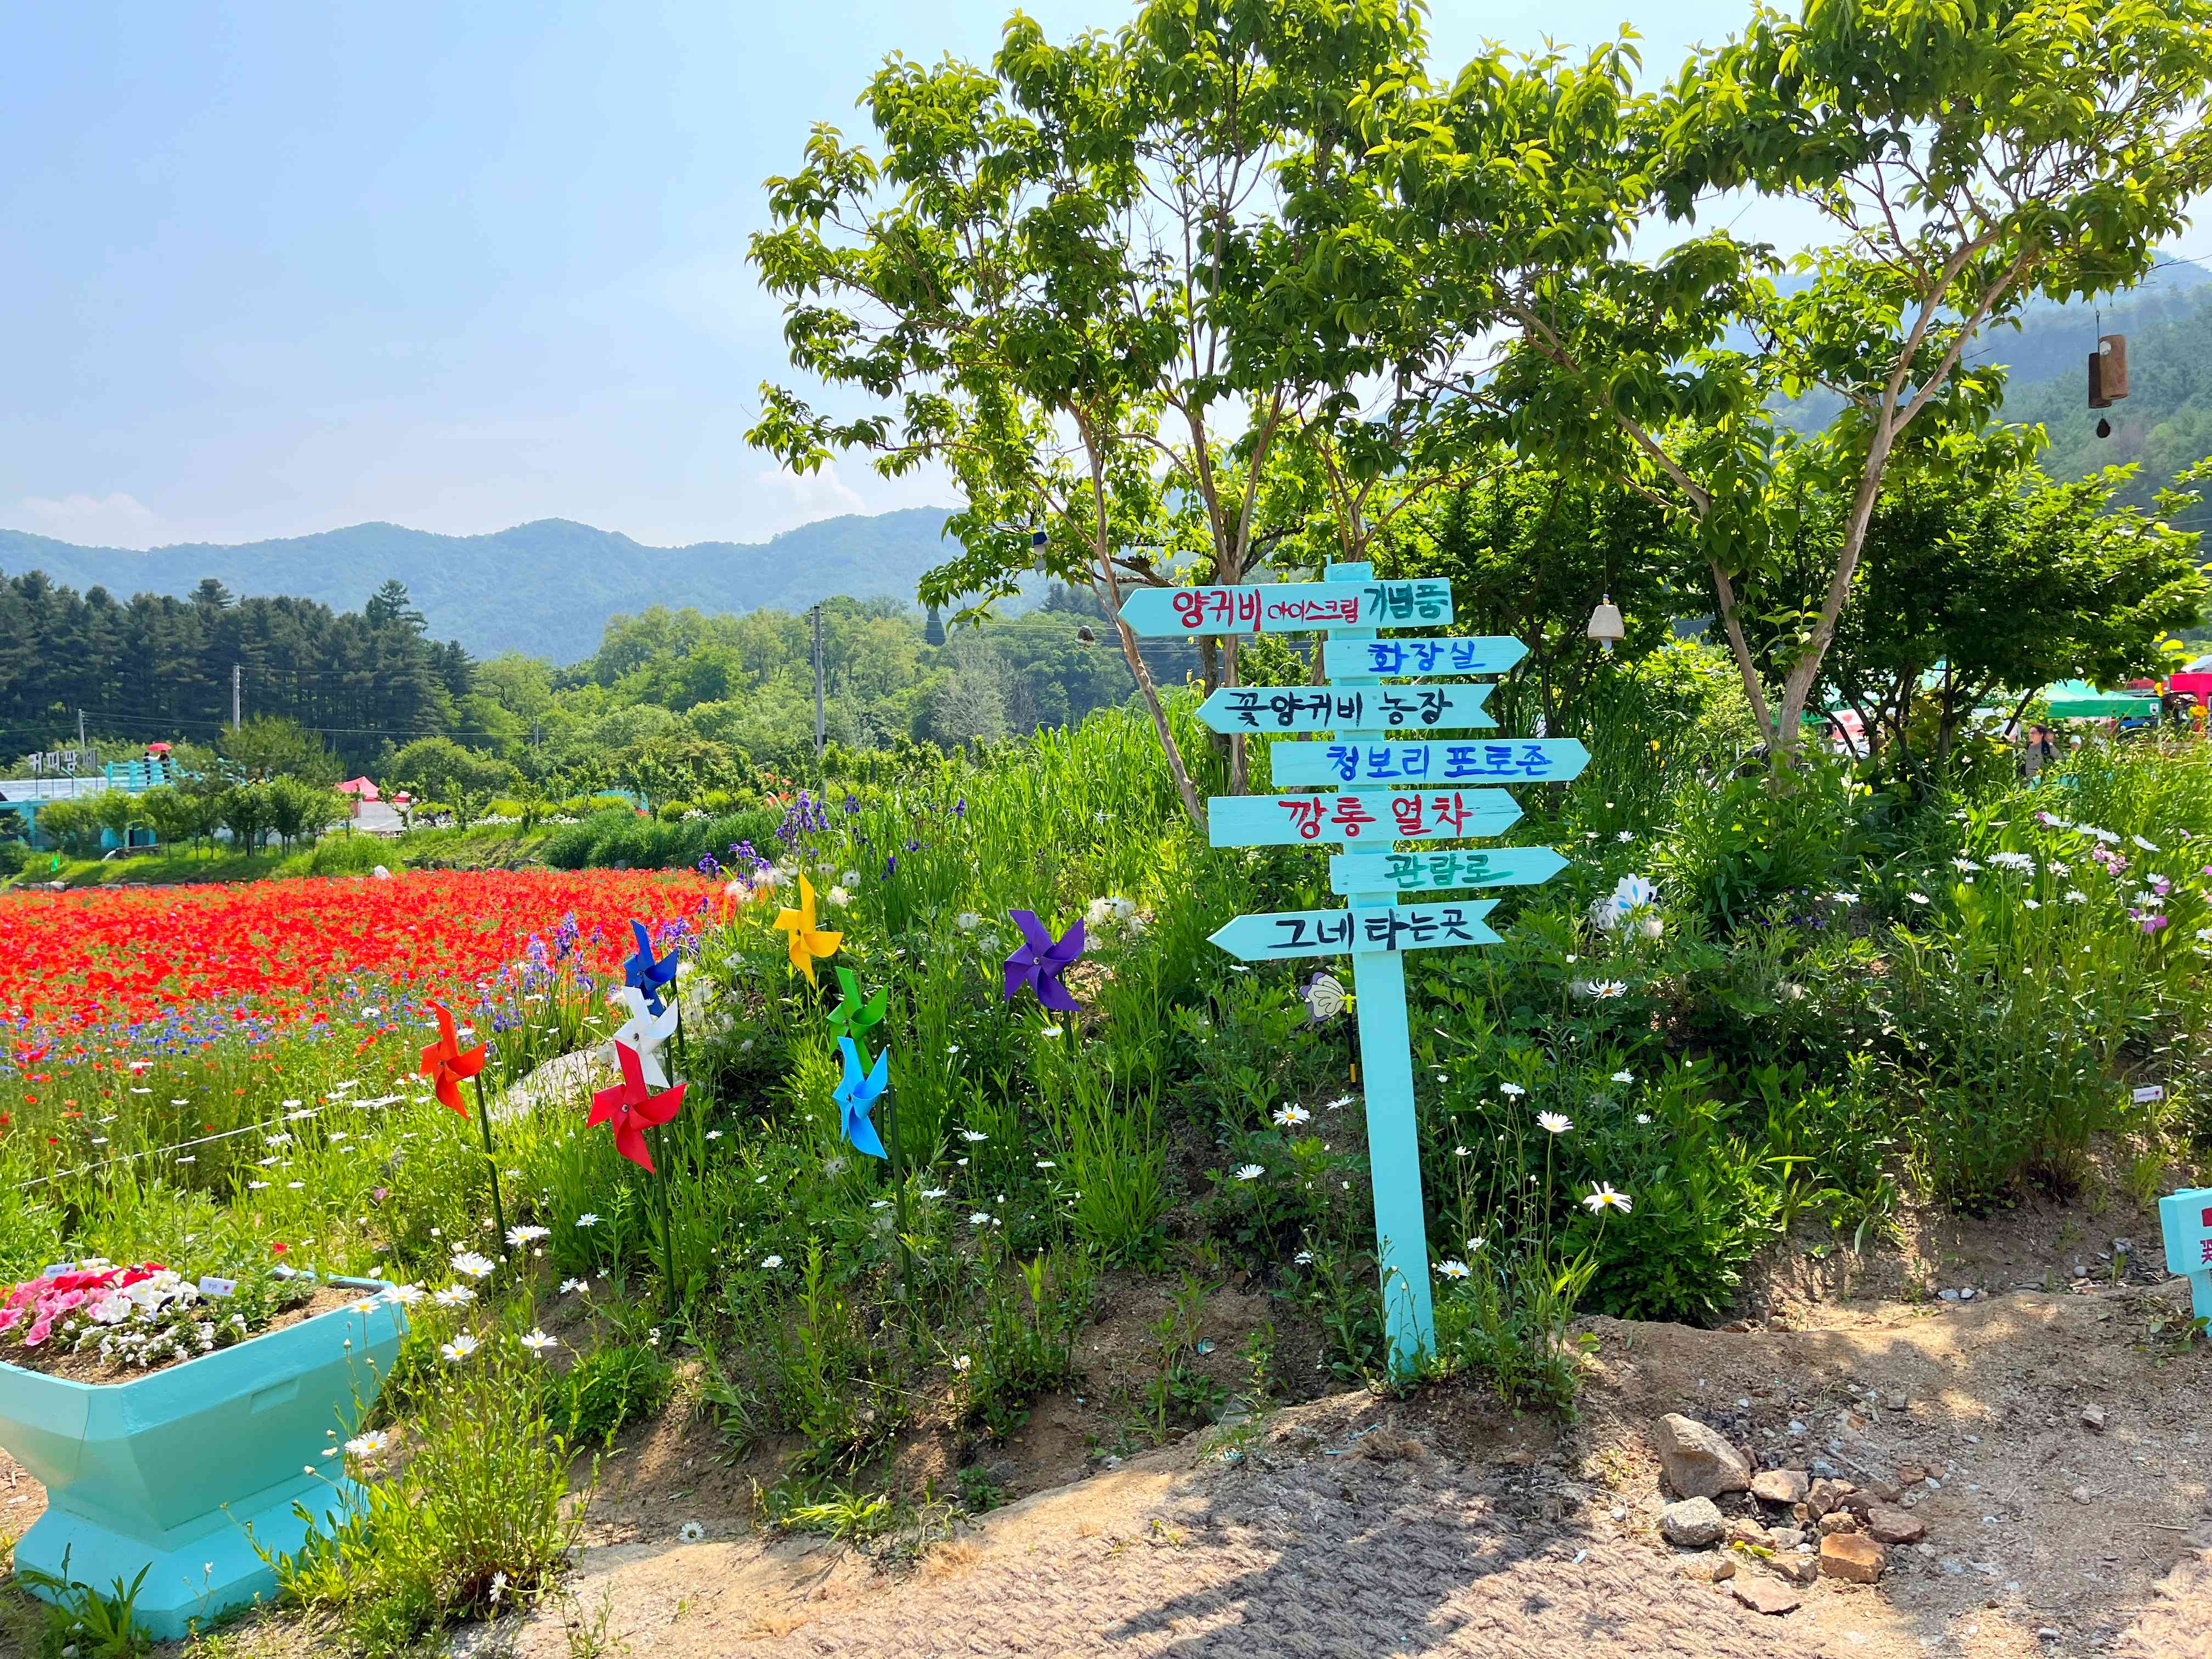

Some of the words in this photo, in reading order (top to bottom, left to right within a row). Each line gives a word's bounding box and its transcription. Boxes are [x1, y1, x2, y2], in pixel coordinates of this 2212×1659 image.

[1172, 588, 1262, 632] 양귀비
[1267, 596, 1359, 624] 아이스크림
[1368, 640, 1486, 674] 화장실
[1224, 691, 1364, 728] 꽃양귀비
[1378, 688, 1454, 725] 농장
[1325, 744, 1428, 782] 청보리
[1443, 744, 1553, 778] 포토존
[1278, 795, 1377, 840] 깡통
[1391, 792, 1474, 838] 열차
[1384, 854, 1514, 889] 관람로
[1267, 912, 1354, 951] 그네
[1364, 907, 1475, 951] 타는곳
